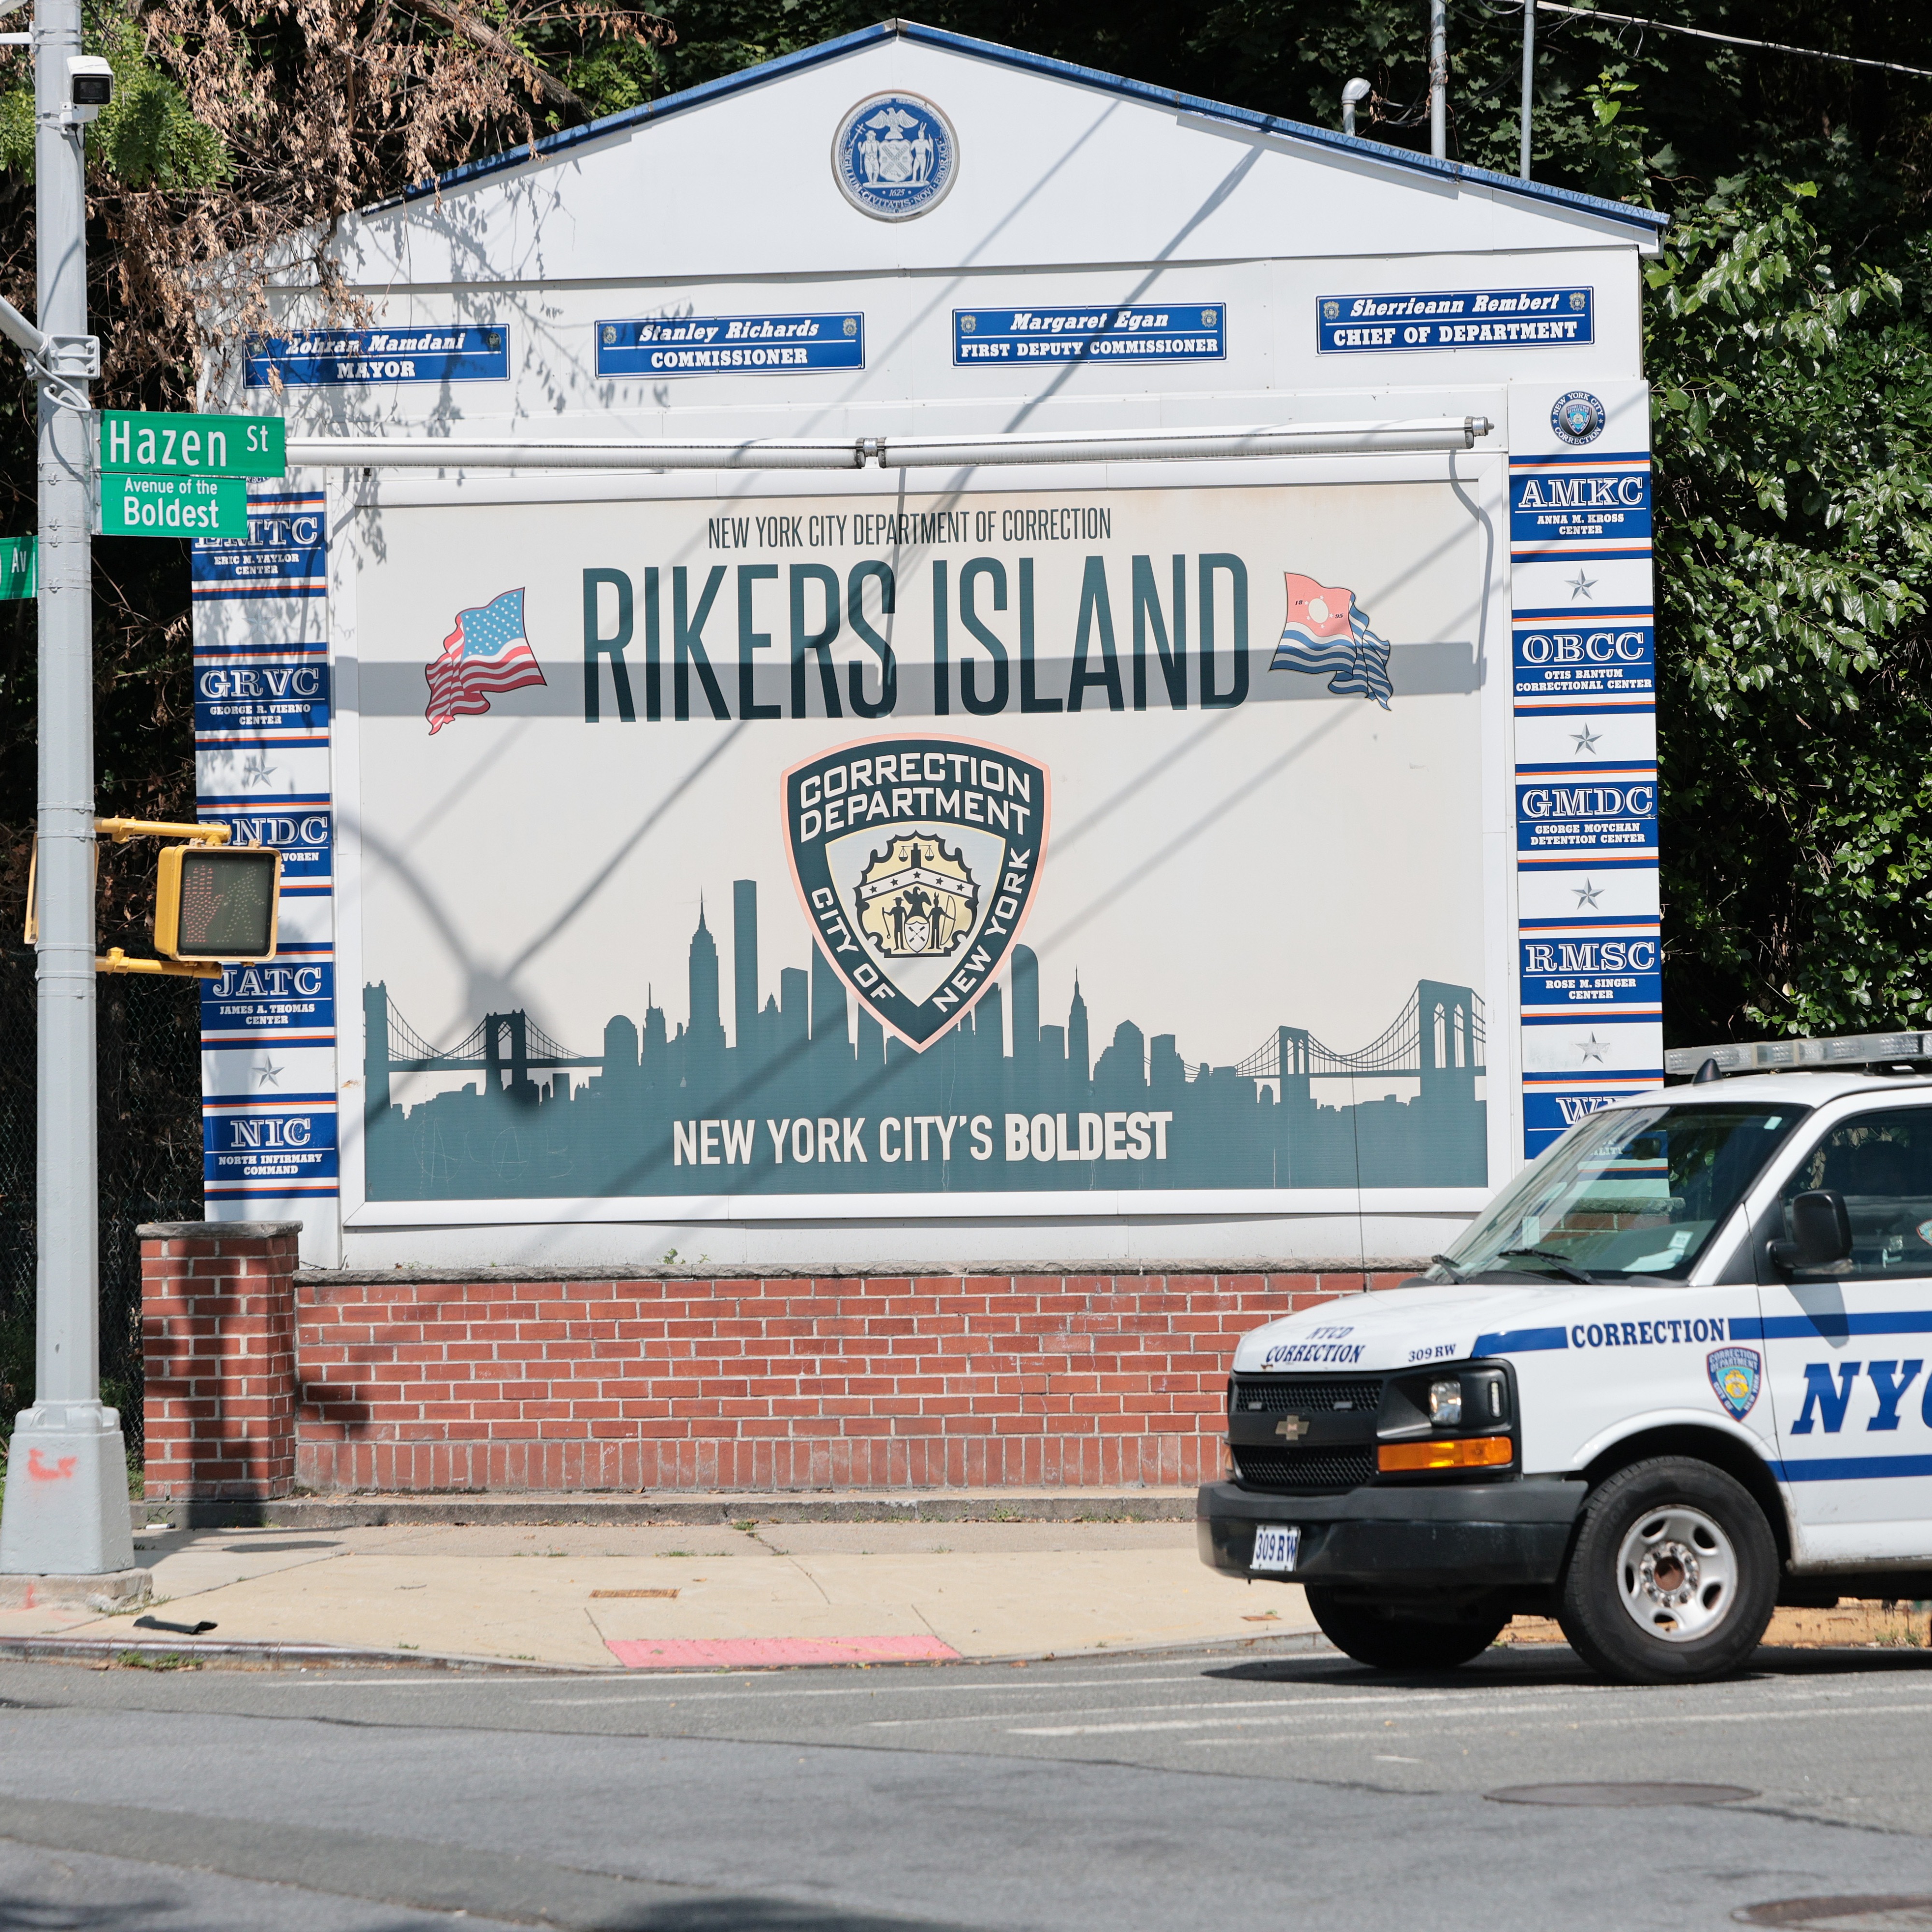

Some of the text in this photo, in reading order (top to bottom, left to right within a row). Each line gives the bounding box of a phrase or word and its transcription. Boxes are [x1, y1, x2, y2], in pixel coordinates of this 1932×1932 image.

[862, 191, 911, 208] CIVITATIS
[915, 187, 935, 204] NOVI
[1350, 294, 1560, 317] Sherrieann Rembert
[639, 320, 819, 342] Stanley Richards
[1010, 311, 1169, 332] Margaret Egan
[368, 333, 466, 352] Mamdani
[1333, 321, 1577, 346] CHIEF OF DEPARTMENT
[961, 339, 1218, 357] FIRST DEPUTY COMMISSIONER
[651, 348, 808, 369] COMMISSIONER
[337, 361, 415, 379] MAYOR
[1553, 392, 1603, 416] NEW YORK CITY
[110, 420, 269, 467] Hazen St
[1555, 426, 1601, 444] CORRECTION
[124, 477, 217, 495] Avenue of the
[1518, 477, 1643, 508] AMKC
[124, 496, 219, 528] Boldest
[1537, 513, 1624, 524] ANNA M. KROSS
[708, 508, 1111, 549] NEW YORK CITY DEPARTMENT OF CORRECTION
[1559, 526, 1603, 535] CENTER
[215, 554, 300, 565] ERIC M. TAYLOR
[236, 565, 278, 575] CENTER
[583, 552, 1249, 724] RIKERS ISLAND
[1522, 632, 1644, 663] OBCC
[200, 668, 319, 698] GRVC
[1545, 669, 1623, 680] OTIS BANTUM
[1516, 679, 1652, 692] CORRECTIONAL CENTER
[210, 704, 311, 715] GEORGE R. VIERNO
[239, 715, 282, 725] CENTER
[801, 753, 1030, 810] CORRECTION
[1522, 786, 1652, 818] GMDC
[801, 787, 1030, 843] DEPARTMENT
[1535, 823, 1640, 834] GEORGE MOTCHAN
[1531, 834, 1645, 845] DETENTION CENTER
[281, 852, 319, 862] VOREN
[932, 847, 1030, 1013] NEW YORK
[811, 886, 896, 1000] CITY OF
[1525, 942, 1654, 972] RMSC
[213, 967, 321, 997] JATC
[1546, 979, 1636, 989] ROSE M. SINGER
[1569, 990, 1613, 999] CENTER
[220, 1004, 315, 1015] JAMES A. THOMAS
[245, 1015, 288, 1024] CENTER
[230, 1118, 311, 1147] NIC
[673, 1111, 1173, 1165] NEW YORK CITY'S BOLDEST
[218, 1153, 323, 1165] NORTH INFIRMARY
[243, 1165, 298, 1175] COMMAND
[1305, 1326, 1354, 1340] NYCD
[1571, 1318, 1725, 1348] CORRECTION
[1266, 1344, 1366, 1364] CORRECTION
[1408, 1347, 1432, 1363] 309
[1709, 1349, 1758, 1362] CORRECTION
[1710, 1357, 1758, 1373] DEPARTMENT
[1790, 1359, 1932, 1435] NY
[1256, 1533, 1275, 1561] 309
